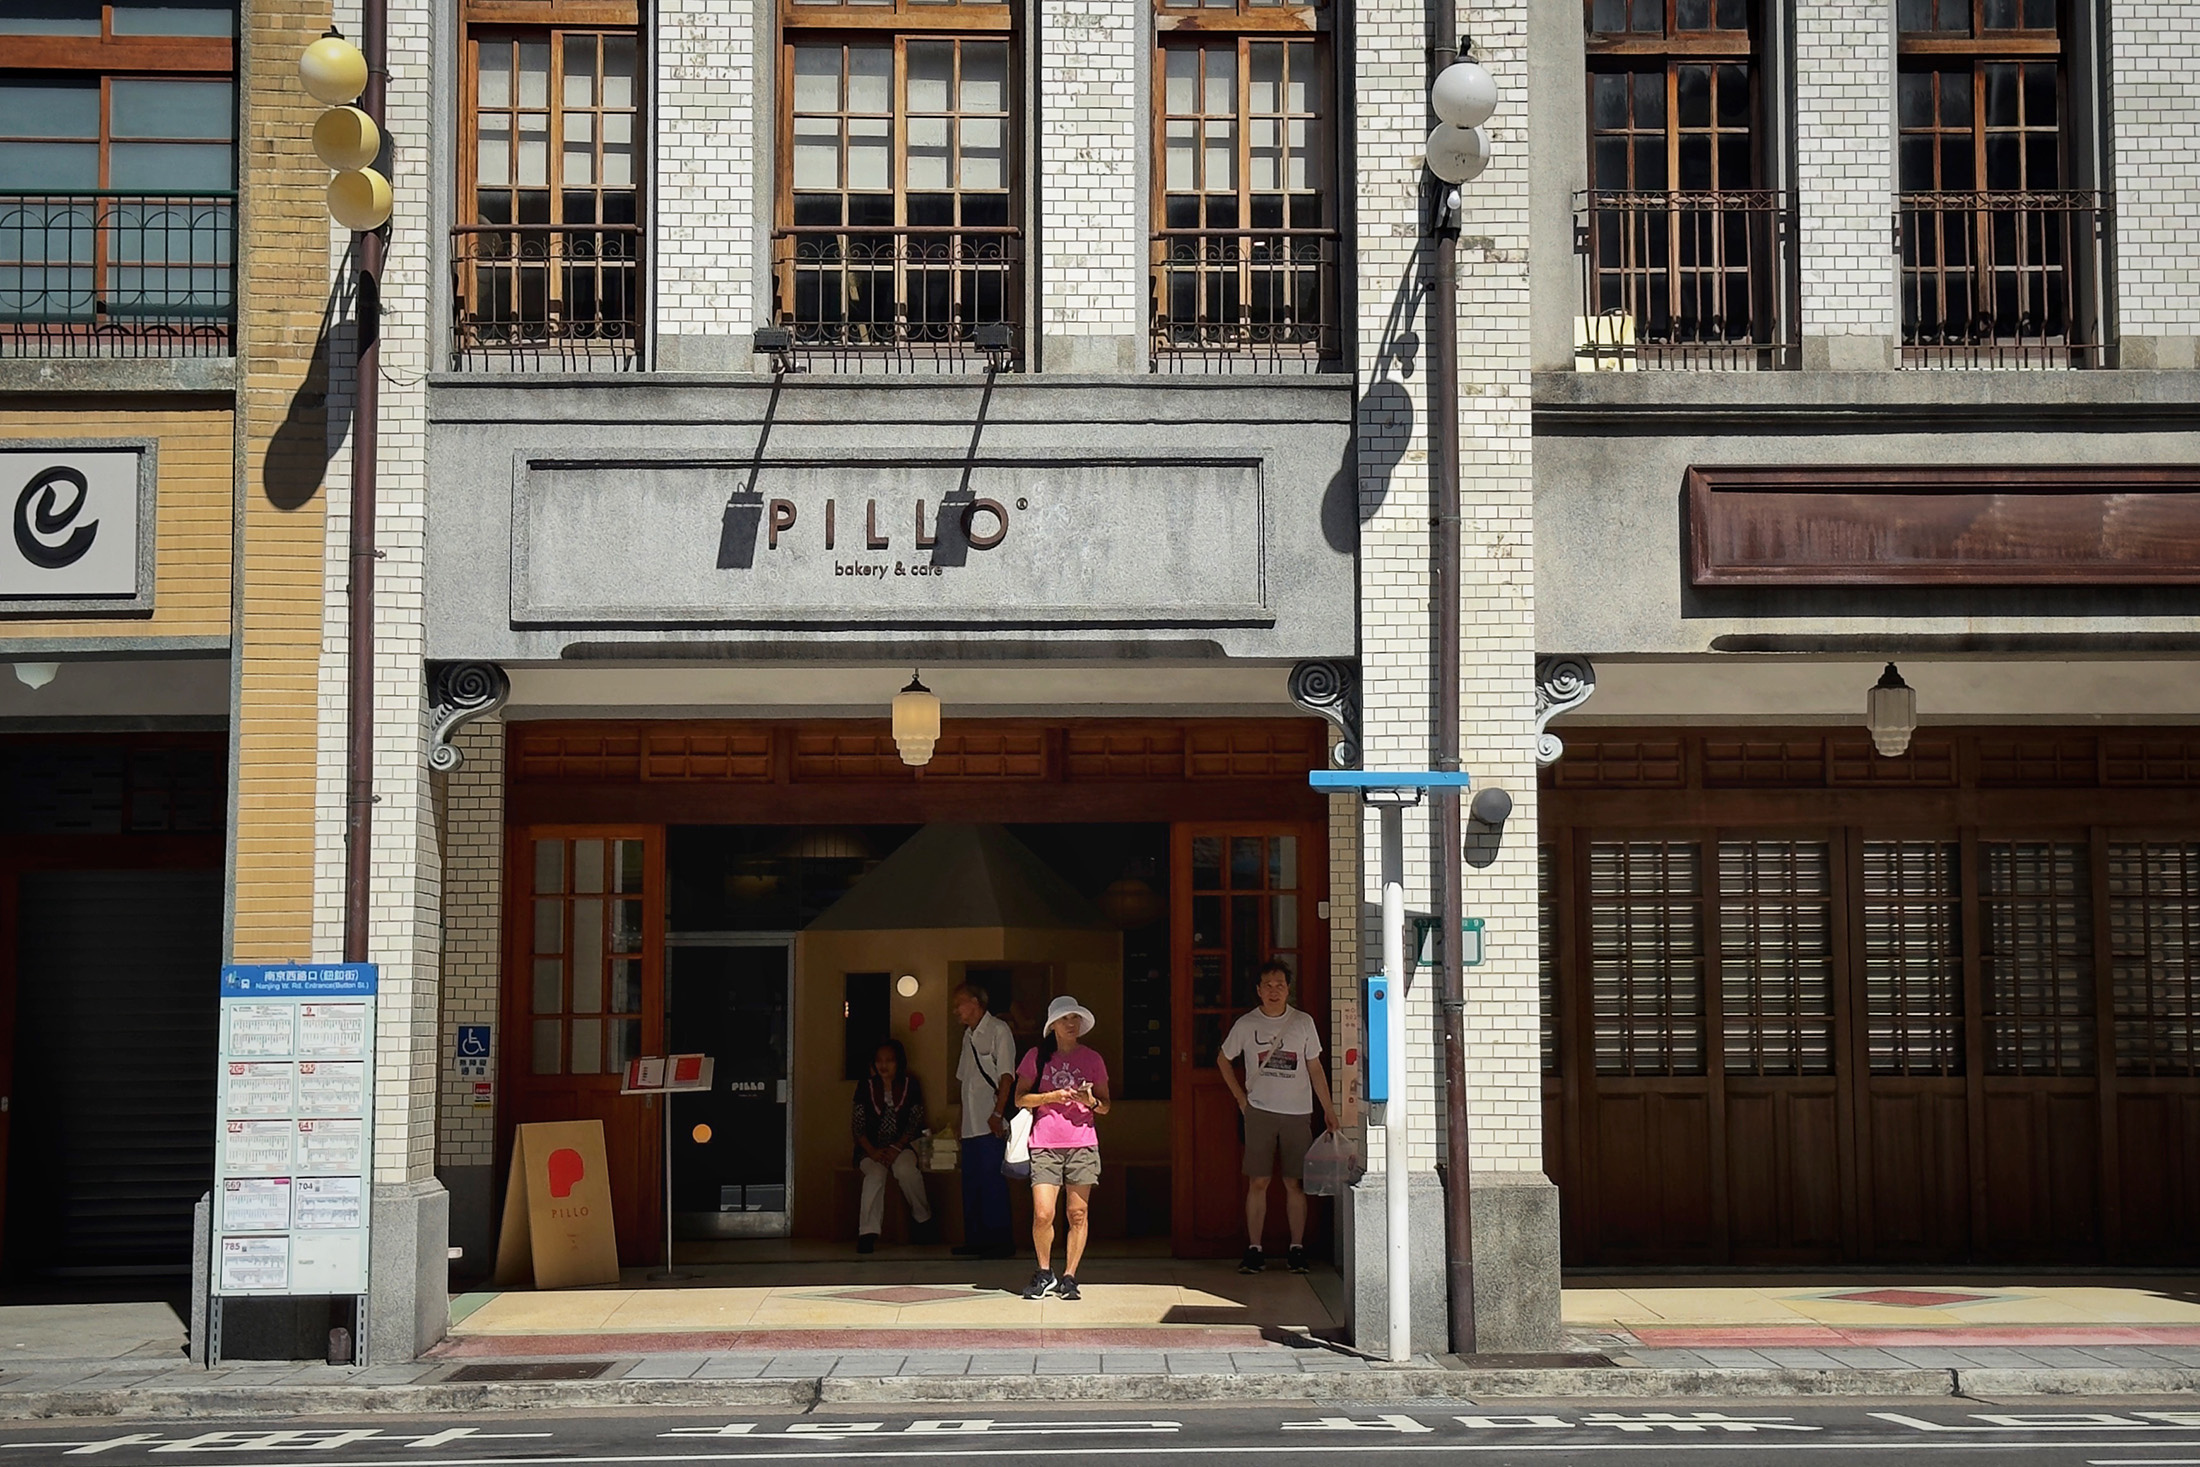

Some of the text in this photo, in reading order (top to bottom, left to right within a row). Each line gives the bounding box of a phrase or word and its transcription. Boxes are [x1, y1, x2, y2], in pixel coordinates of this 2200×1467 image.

[835, 560, 888, 580] bakery
[894, 561, 906, 576] &
[255, 982, 280, 990] Nanjing
[306, 1006, 312, 1014] 9
[299, 1064, 316, 1072] 255
[227, 1122, 243, 1131] 274
[298, 1182, 313, 1190] 704
[551, 1206, 589, 1219] PILLO
[224, 1242, 240, 1250] 785
